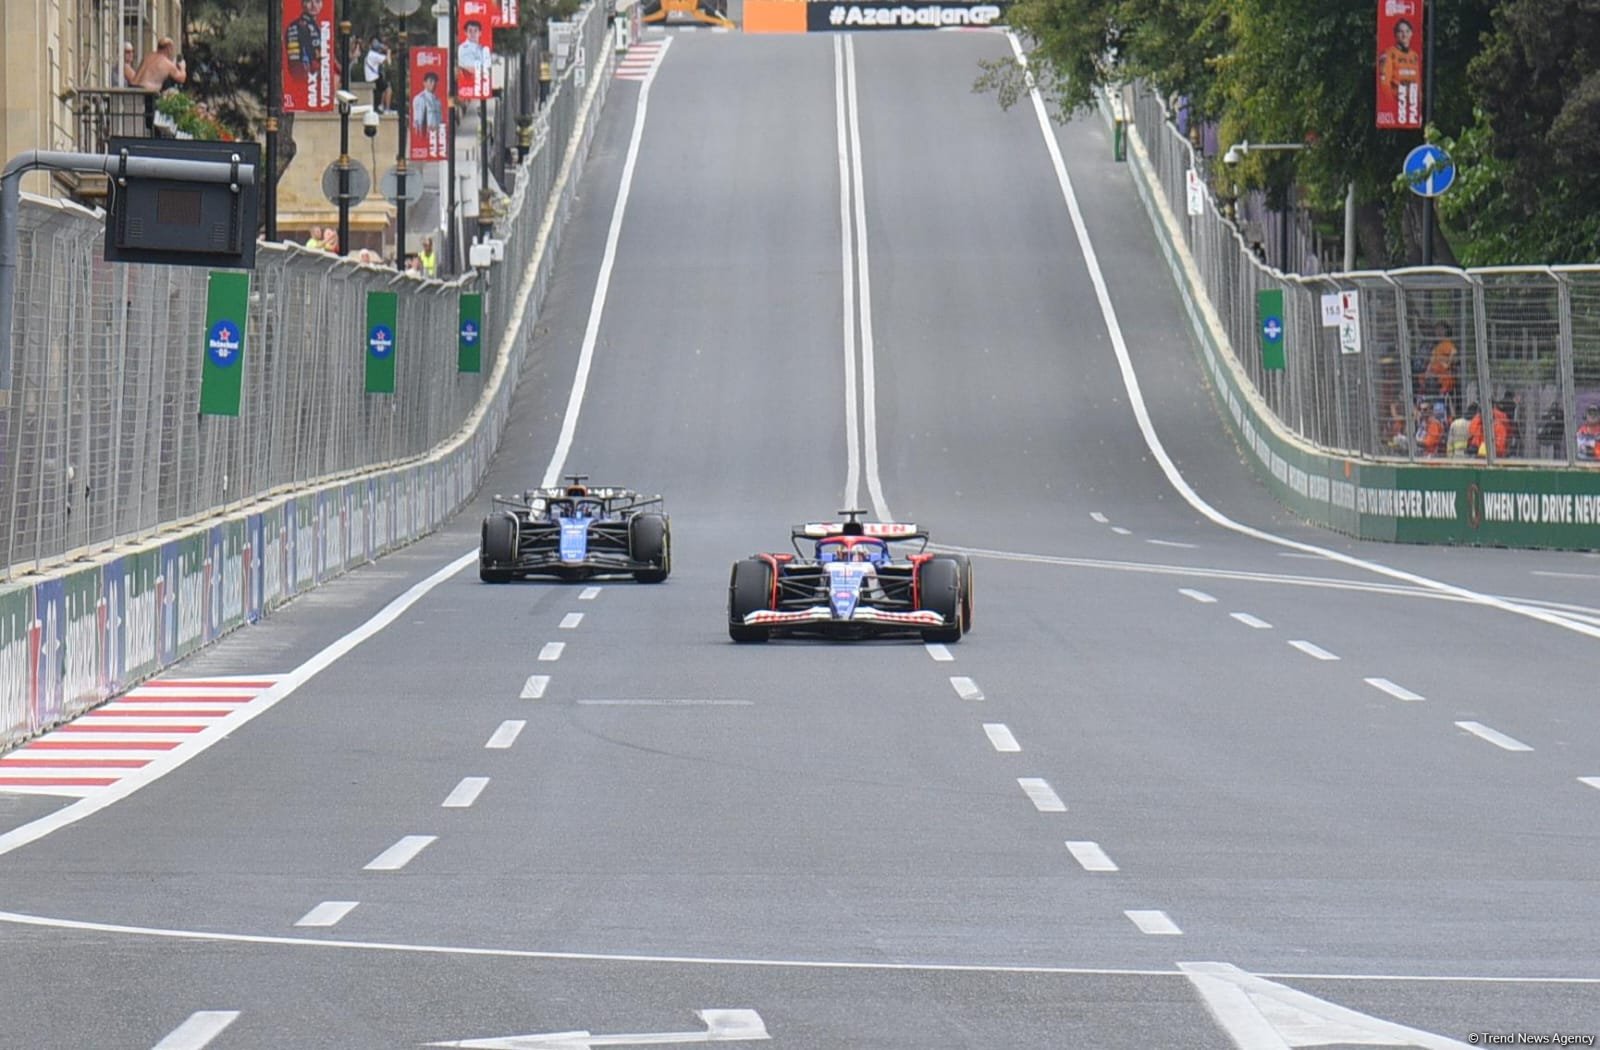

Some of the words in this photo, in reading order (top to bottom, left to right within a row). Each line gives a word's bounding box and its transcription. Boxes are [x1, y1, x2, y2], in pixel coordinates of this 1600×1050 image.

[829, 5, 1001, 27] #AzerbaijanGP
[307, 72, 318, 107] MAX
[1393, 489, 1423, 518] NEVER
[1425, 491, 1457, 519] DRINK
[1484, 492, 1514, 522] WHEN
[1516, 493, 1539, 523] YOU
[1542, 494, 1572, 523] DRIVE
[1575, 495, 1600, 524] NEVE
